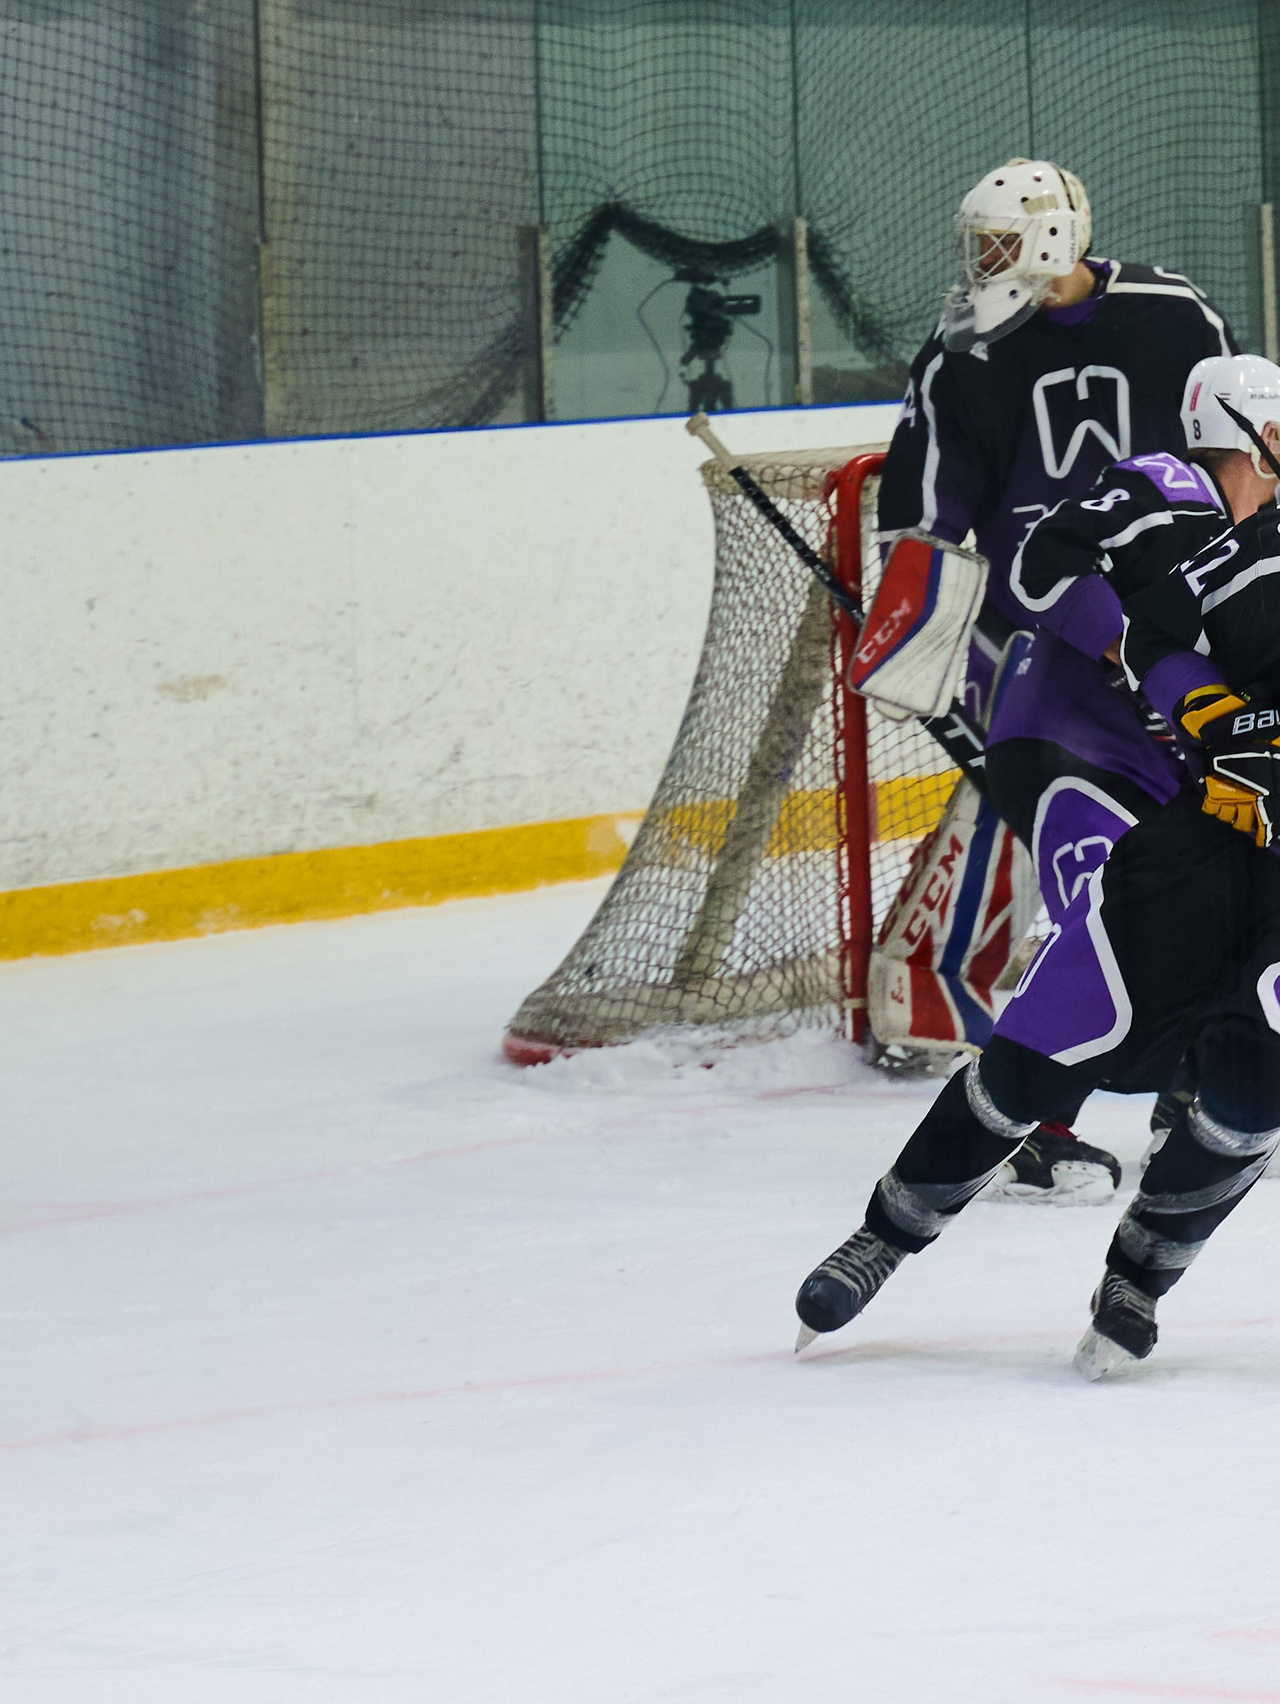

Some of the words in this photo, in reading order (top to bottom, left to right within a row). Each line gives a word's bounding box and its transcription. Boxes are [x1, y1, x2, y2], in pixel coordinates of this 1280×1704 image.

[1192, 418, 1202, 441] 8
[1080, 487, 1131, 512] 8
[856, 597, 912, 664] CCM
[901, 833, 965, 946] CCM
